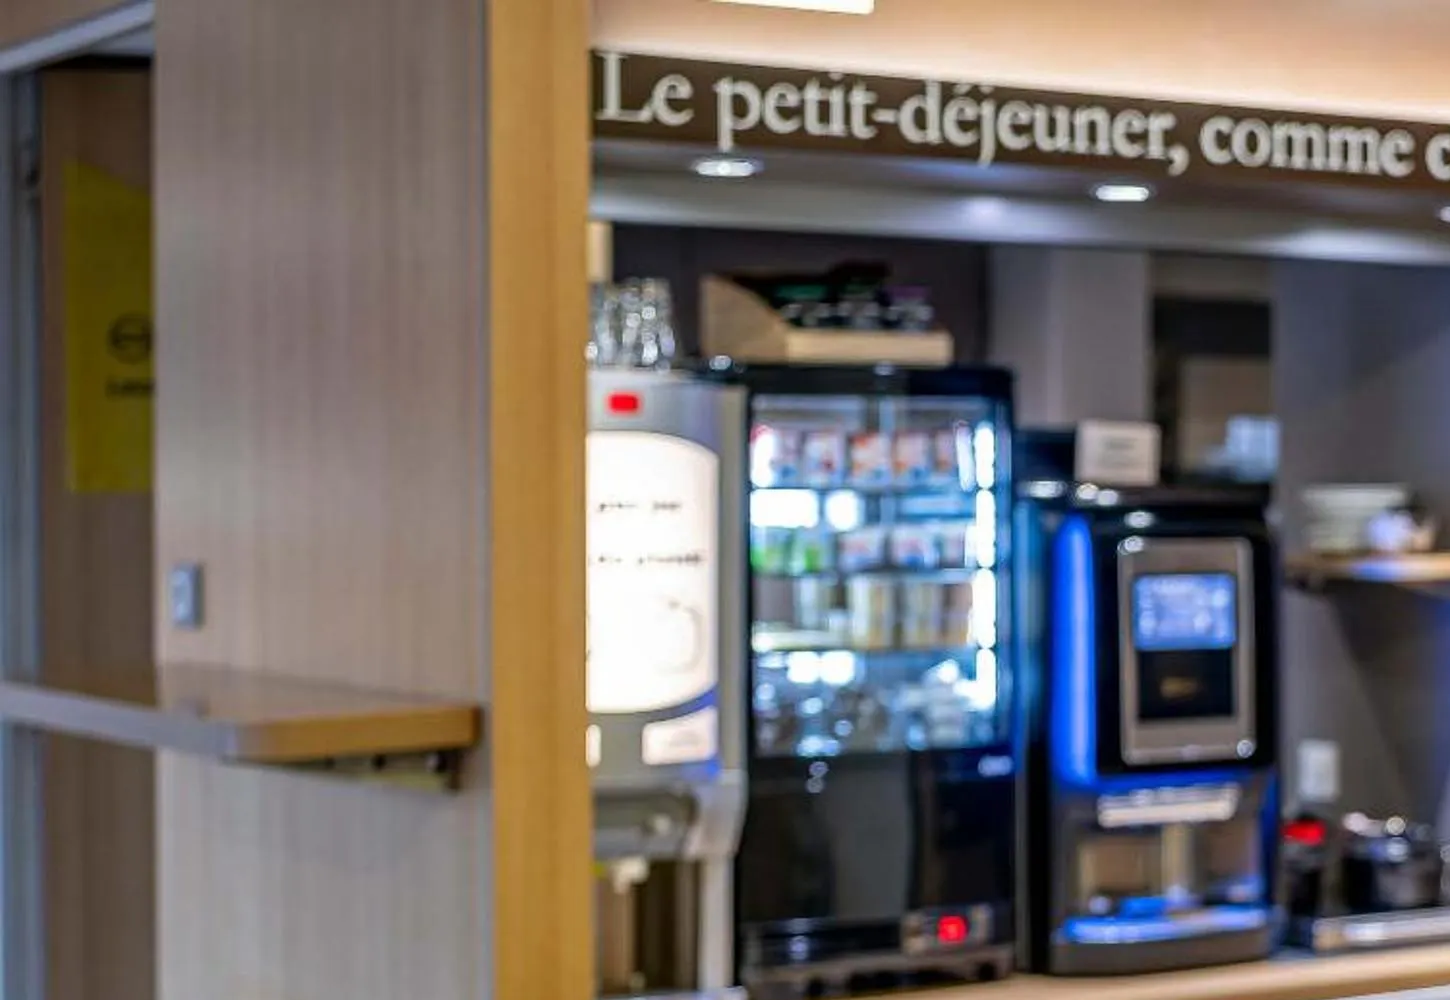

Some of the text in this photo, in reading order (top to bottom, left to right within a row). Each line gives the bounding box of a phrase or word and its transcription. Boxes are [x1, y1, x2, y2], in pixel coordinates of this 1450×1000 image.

[596, 51, 694, 126] Le
[713, 71, 1190, 176] petit-déjeuner,
[1200, 115, 1416, 178] comme
